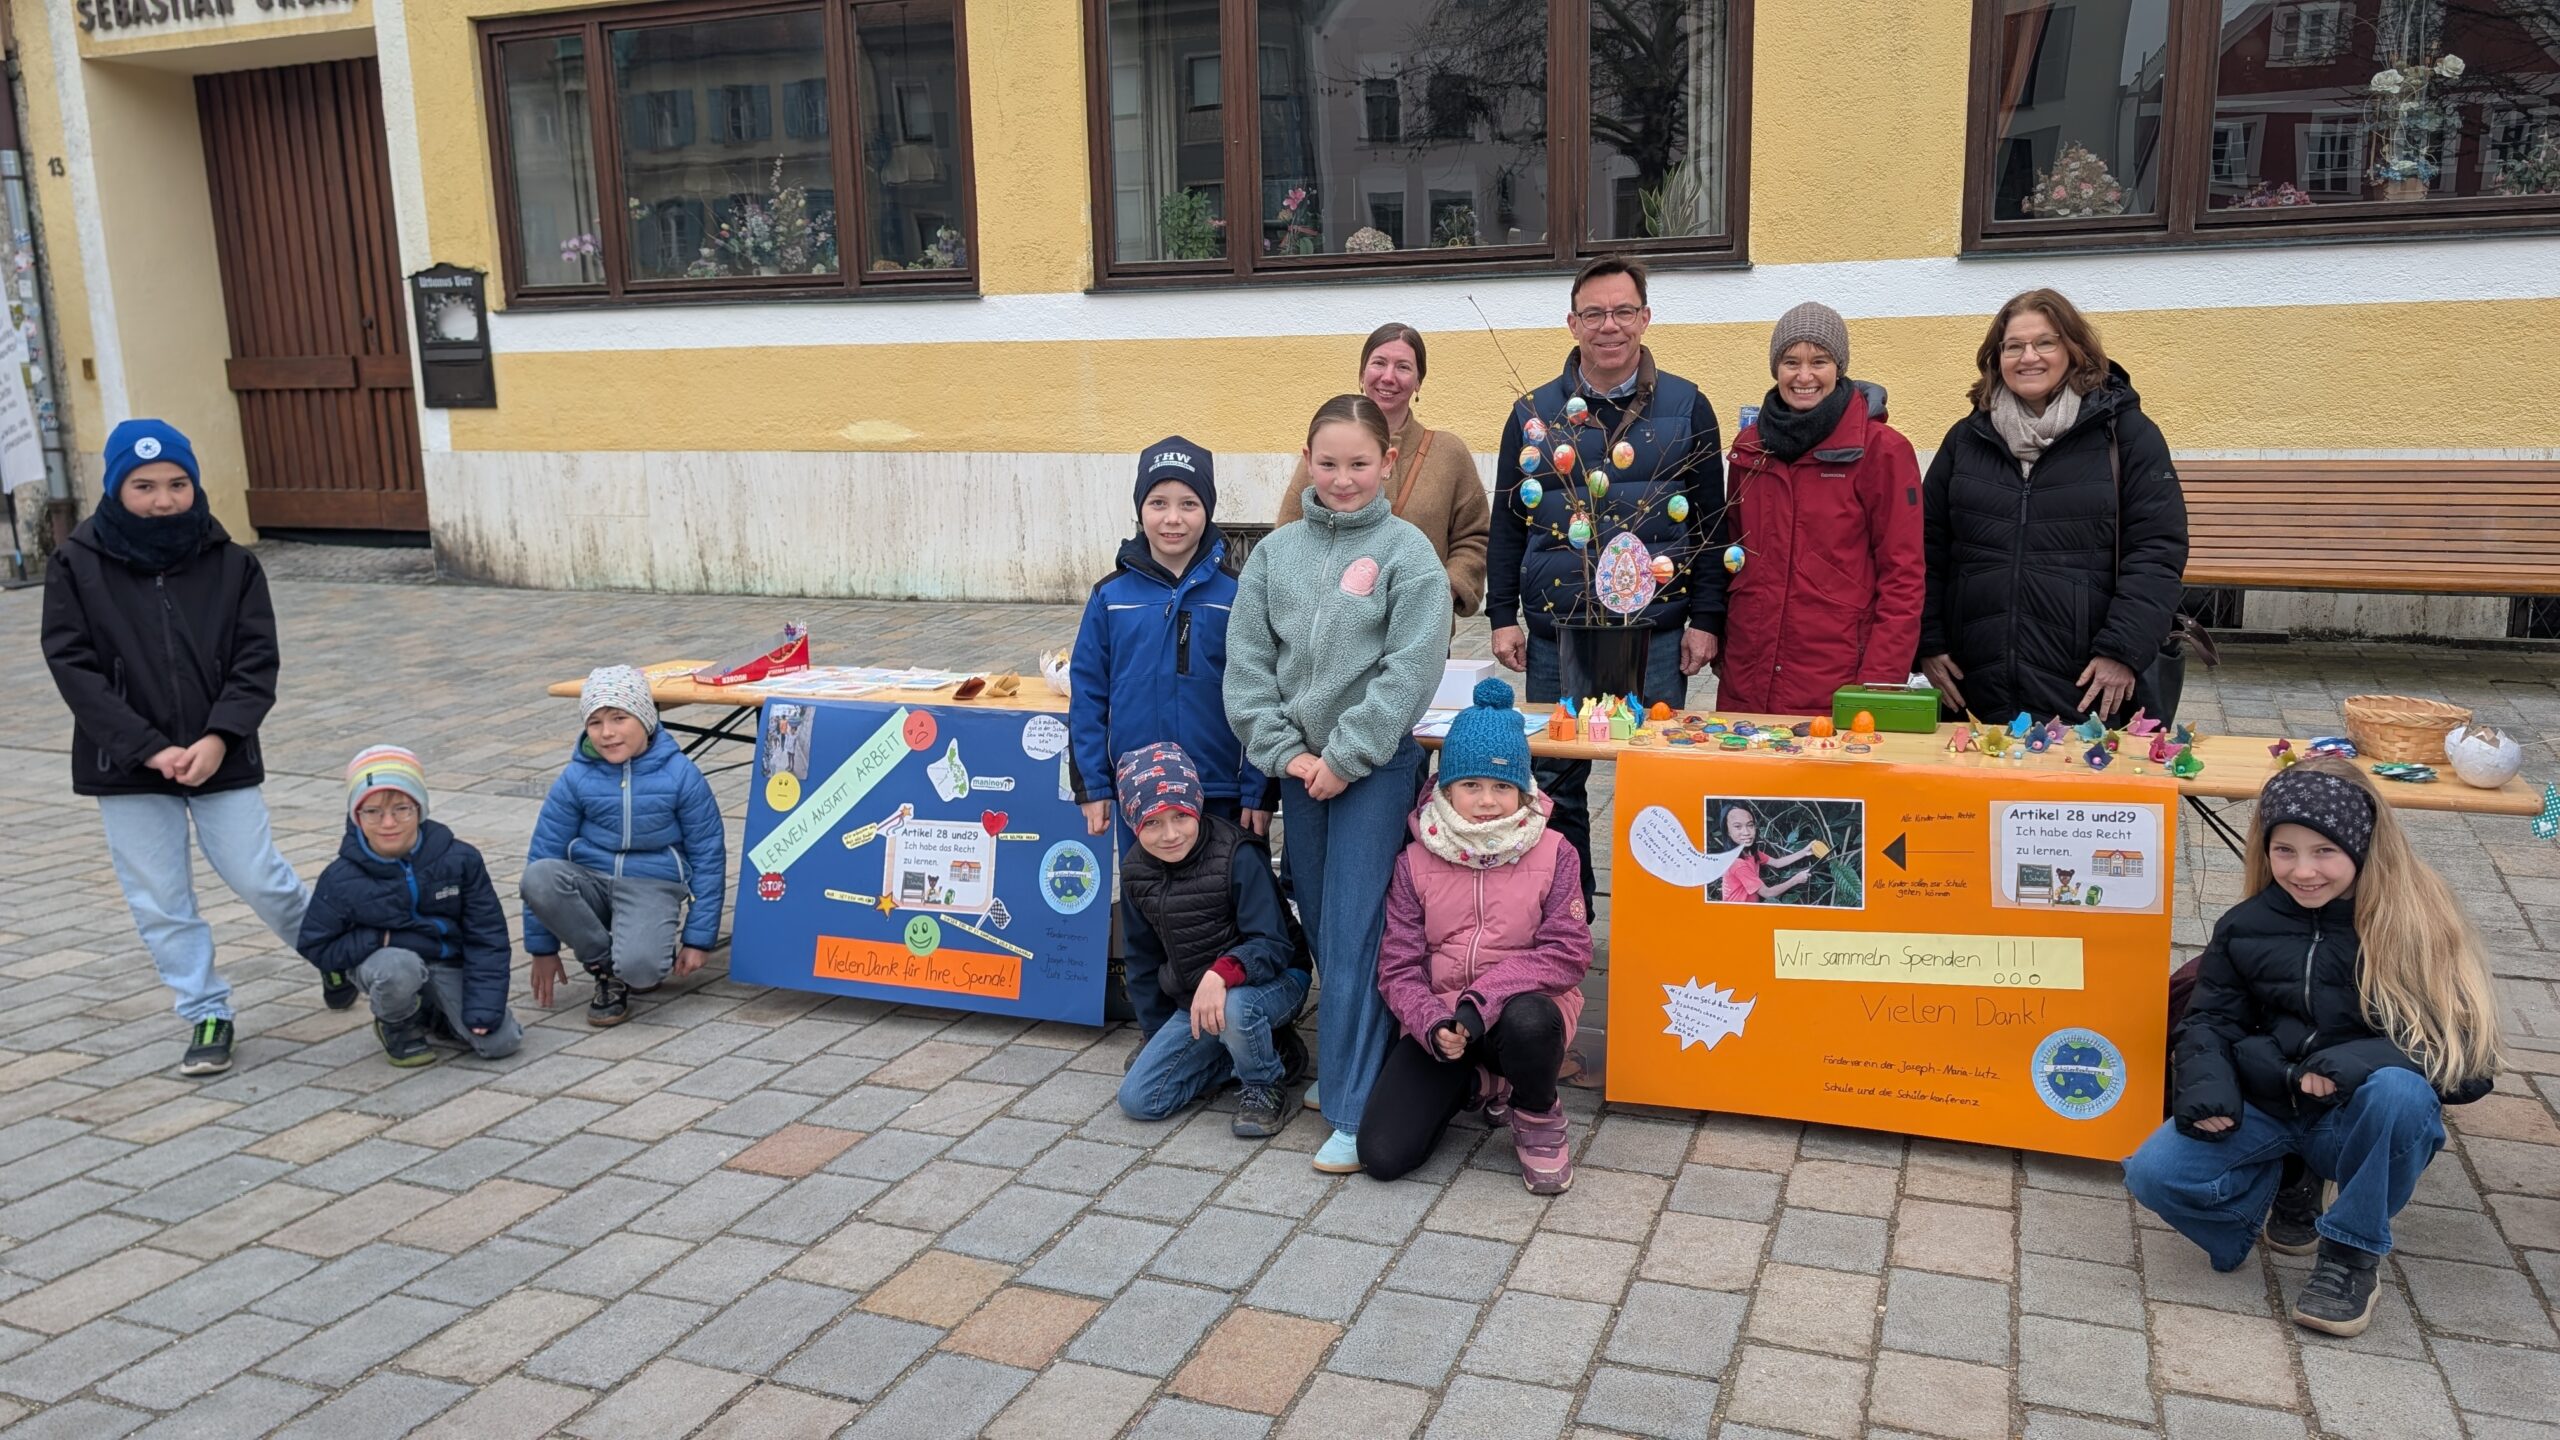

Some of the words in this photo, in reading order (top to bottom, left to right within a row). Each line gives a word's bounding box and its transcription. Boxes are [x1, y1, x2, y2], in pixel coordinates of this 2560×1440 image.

[48, 156, 65, 177] 13
[1153, 452, 1192, 464] THW
[760, 819, 809, 870] LERNEN
[811, 782, 849, 826] ANSTATT
[855, 730, 901, 782] ARBEIT
[2009, 808, 2059, 821] Artikel
[2066, 810, 2085, 822] 28
[2092, 811, 2137, 823] und29
[901, 828, 932, 838] Artikel
[936, 829, 948, 839] 28
[951, 831, 979, 840] und29
[2015, 826, 2036, 837] Ich
[2040, 826, 2068, 838] habe
[2072, 828, 2093, 839] das
[2096, 829, 2133, 840] Recht
[904, 841, 917, 850] Ich
[919, 843, 937, 851] habe
[939, 844, 951, 852] das
[953, 845, 976, 854] Recht
[2016, 846, 2029, 855] zu
[2033, 845, 2073, 857] lernen.
[913, 857, 939, 866] lernen.
[761, 880, 783, 892] STOP
[1873, 879, 1886, 889] Alle
[1888, 879, 1908, 888] Kinder
[1777, 940, 1812, 967] Wir
[1818, 947, 1891, 967] sammeln
[1899, 945, 1981, 972] Spenden
[826, 944, 865, 974] Vielen
[866, 950, 901, 977] Dank
[902, 955, 920, 981] für
[924, 957, 950, 984] Ihre
[953, 961, 1016, 990] Spende!
[1860, 994, 1956, 1025] Vielen
[1975, 996, 2046, 1027] Dank!
[1880, 1060, 1896, 1070] der
[1823, 1082, 1854, 1093] Schule
[1857, 1086, 1876, 1096] und
[1878, 1088, 1893, 1097] die
